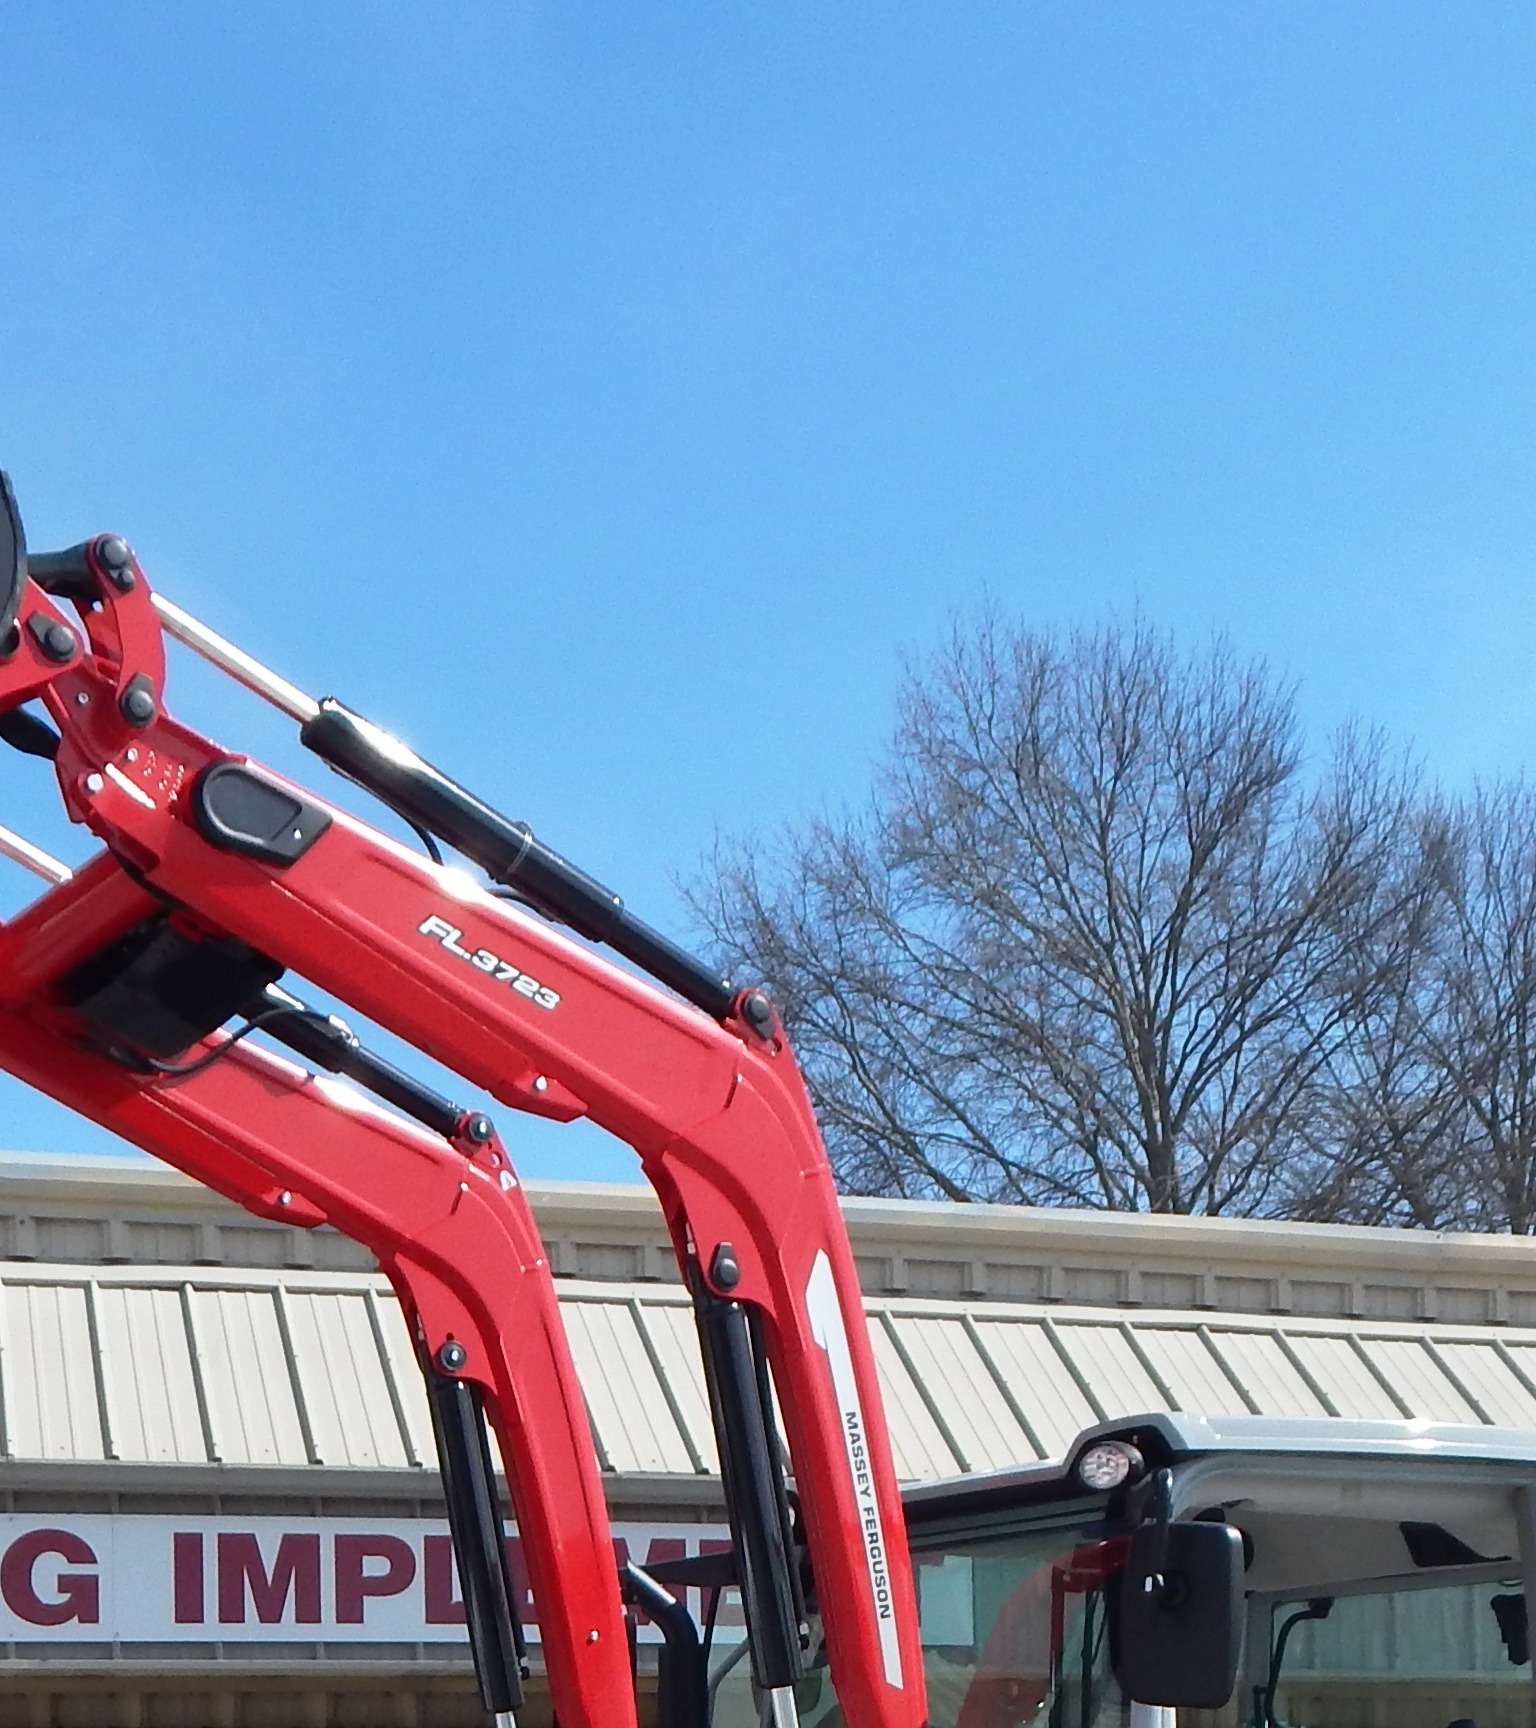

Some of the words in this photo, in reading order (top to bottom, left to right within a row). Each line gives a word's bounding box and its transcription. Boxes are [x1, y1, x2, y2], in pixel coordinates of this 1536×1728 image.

[417, 913, 562, 1011] FL.3723
[845, 1411, 872, 1499] MASSEY
[862, 1506, 891, 1619] FERGUSON
